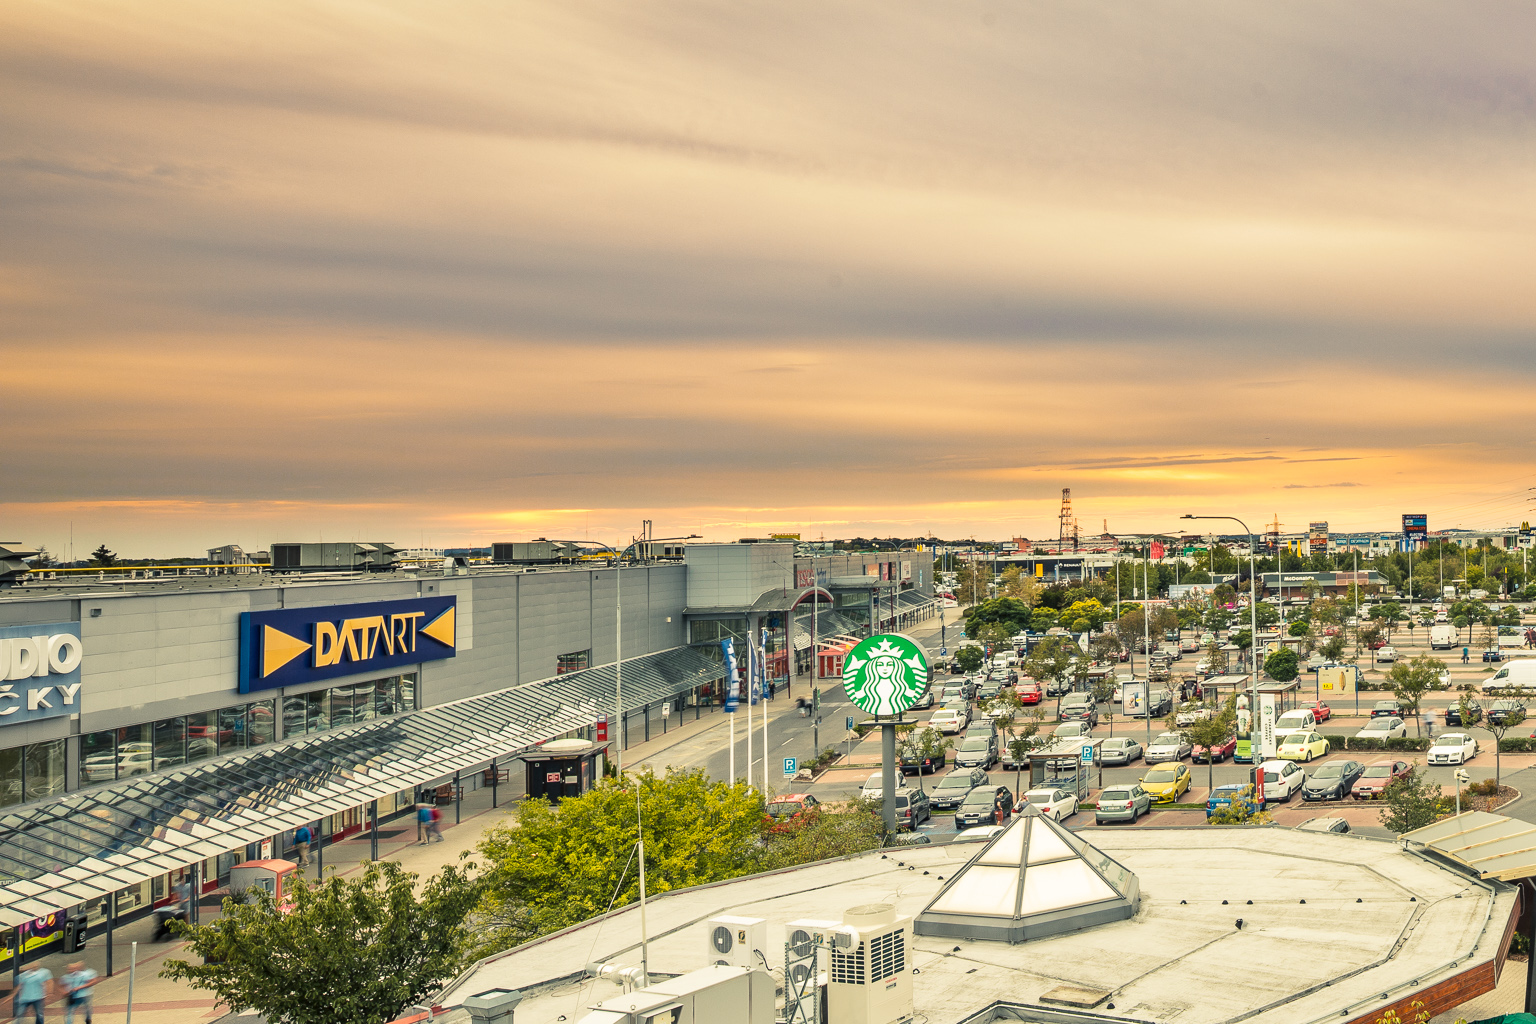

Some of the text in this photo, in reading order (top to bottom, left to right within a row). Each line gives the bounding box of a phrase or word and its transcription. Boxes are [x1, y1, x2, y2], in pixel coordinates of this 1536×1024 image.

[312, 611, 426, 668] DATART
[785, 759, 794, 770] P
[1257, 783, 1264, 800] 1
